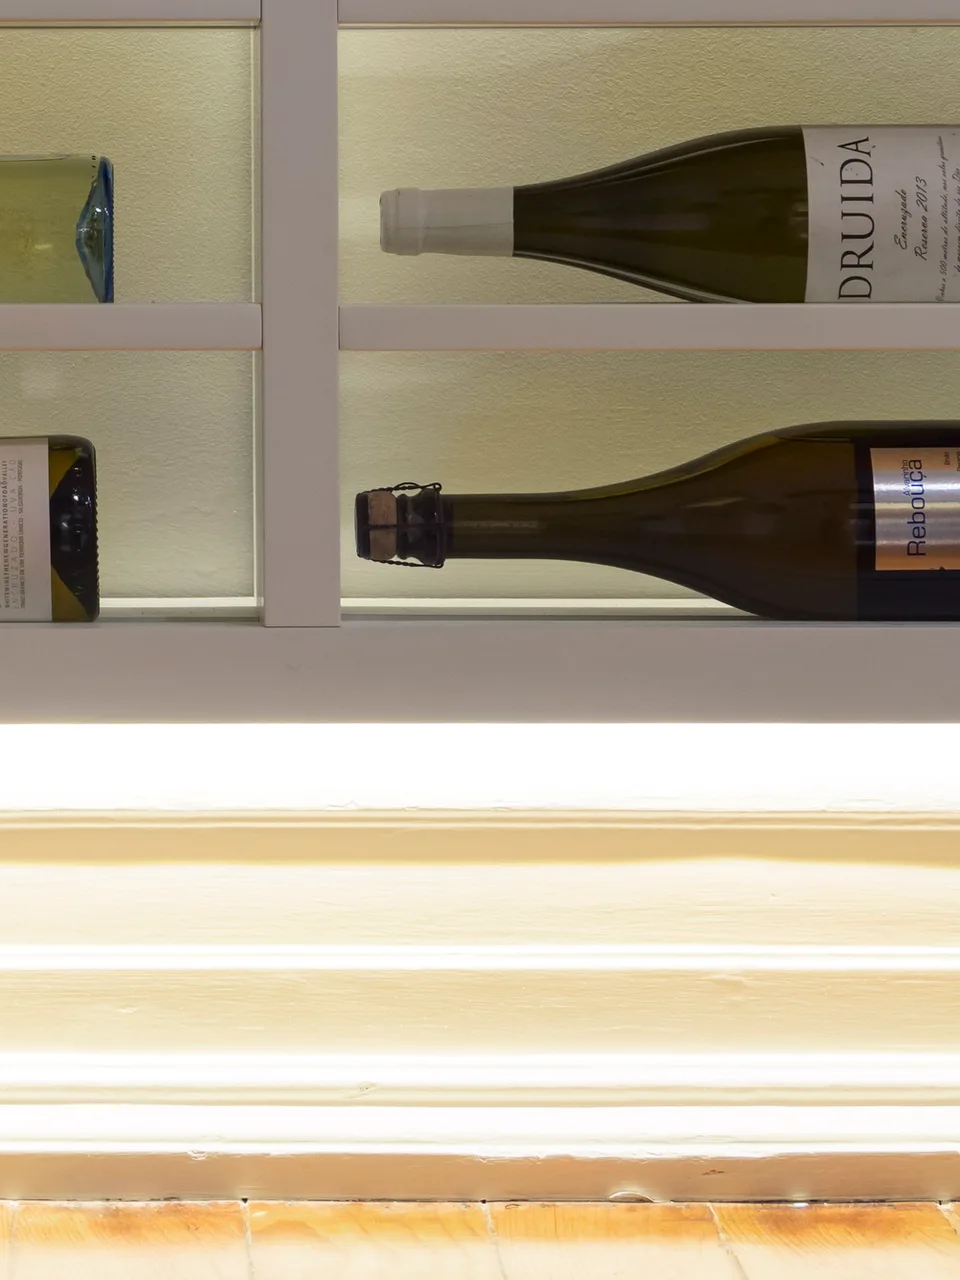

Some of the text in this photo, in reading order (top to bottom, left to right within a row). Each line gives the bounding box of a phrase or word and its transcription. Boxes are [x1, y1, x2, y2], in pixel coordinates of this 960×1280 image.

[836, 136, 875, 300] DRUIDA
[893, 188, 912, 250] Encruzado
[913, 176, 928, 261] Reserva 2013
[907, 459, 927, 556] Rebouça
